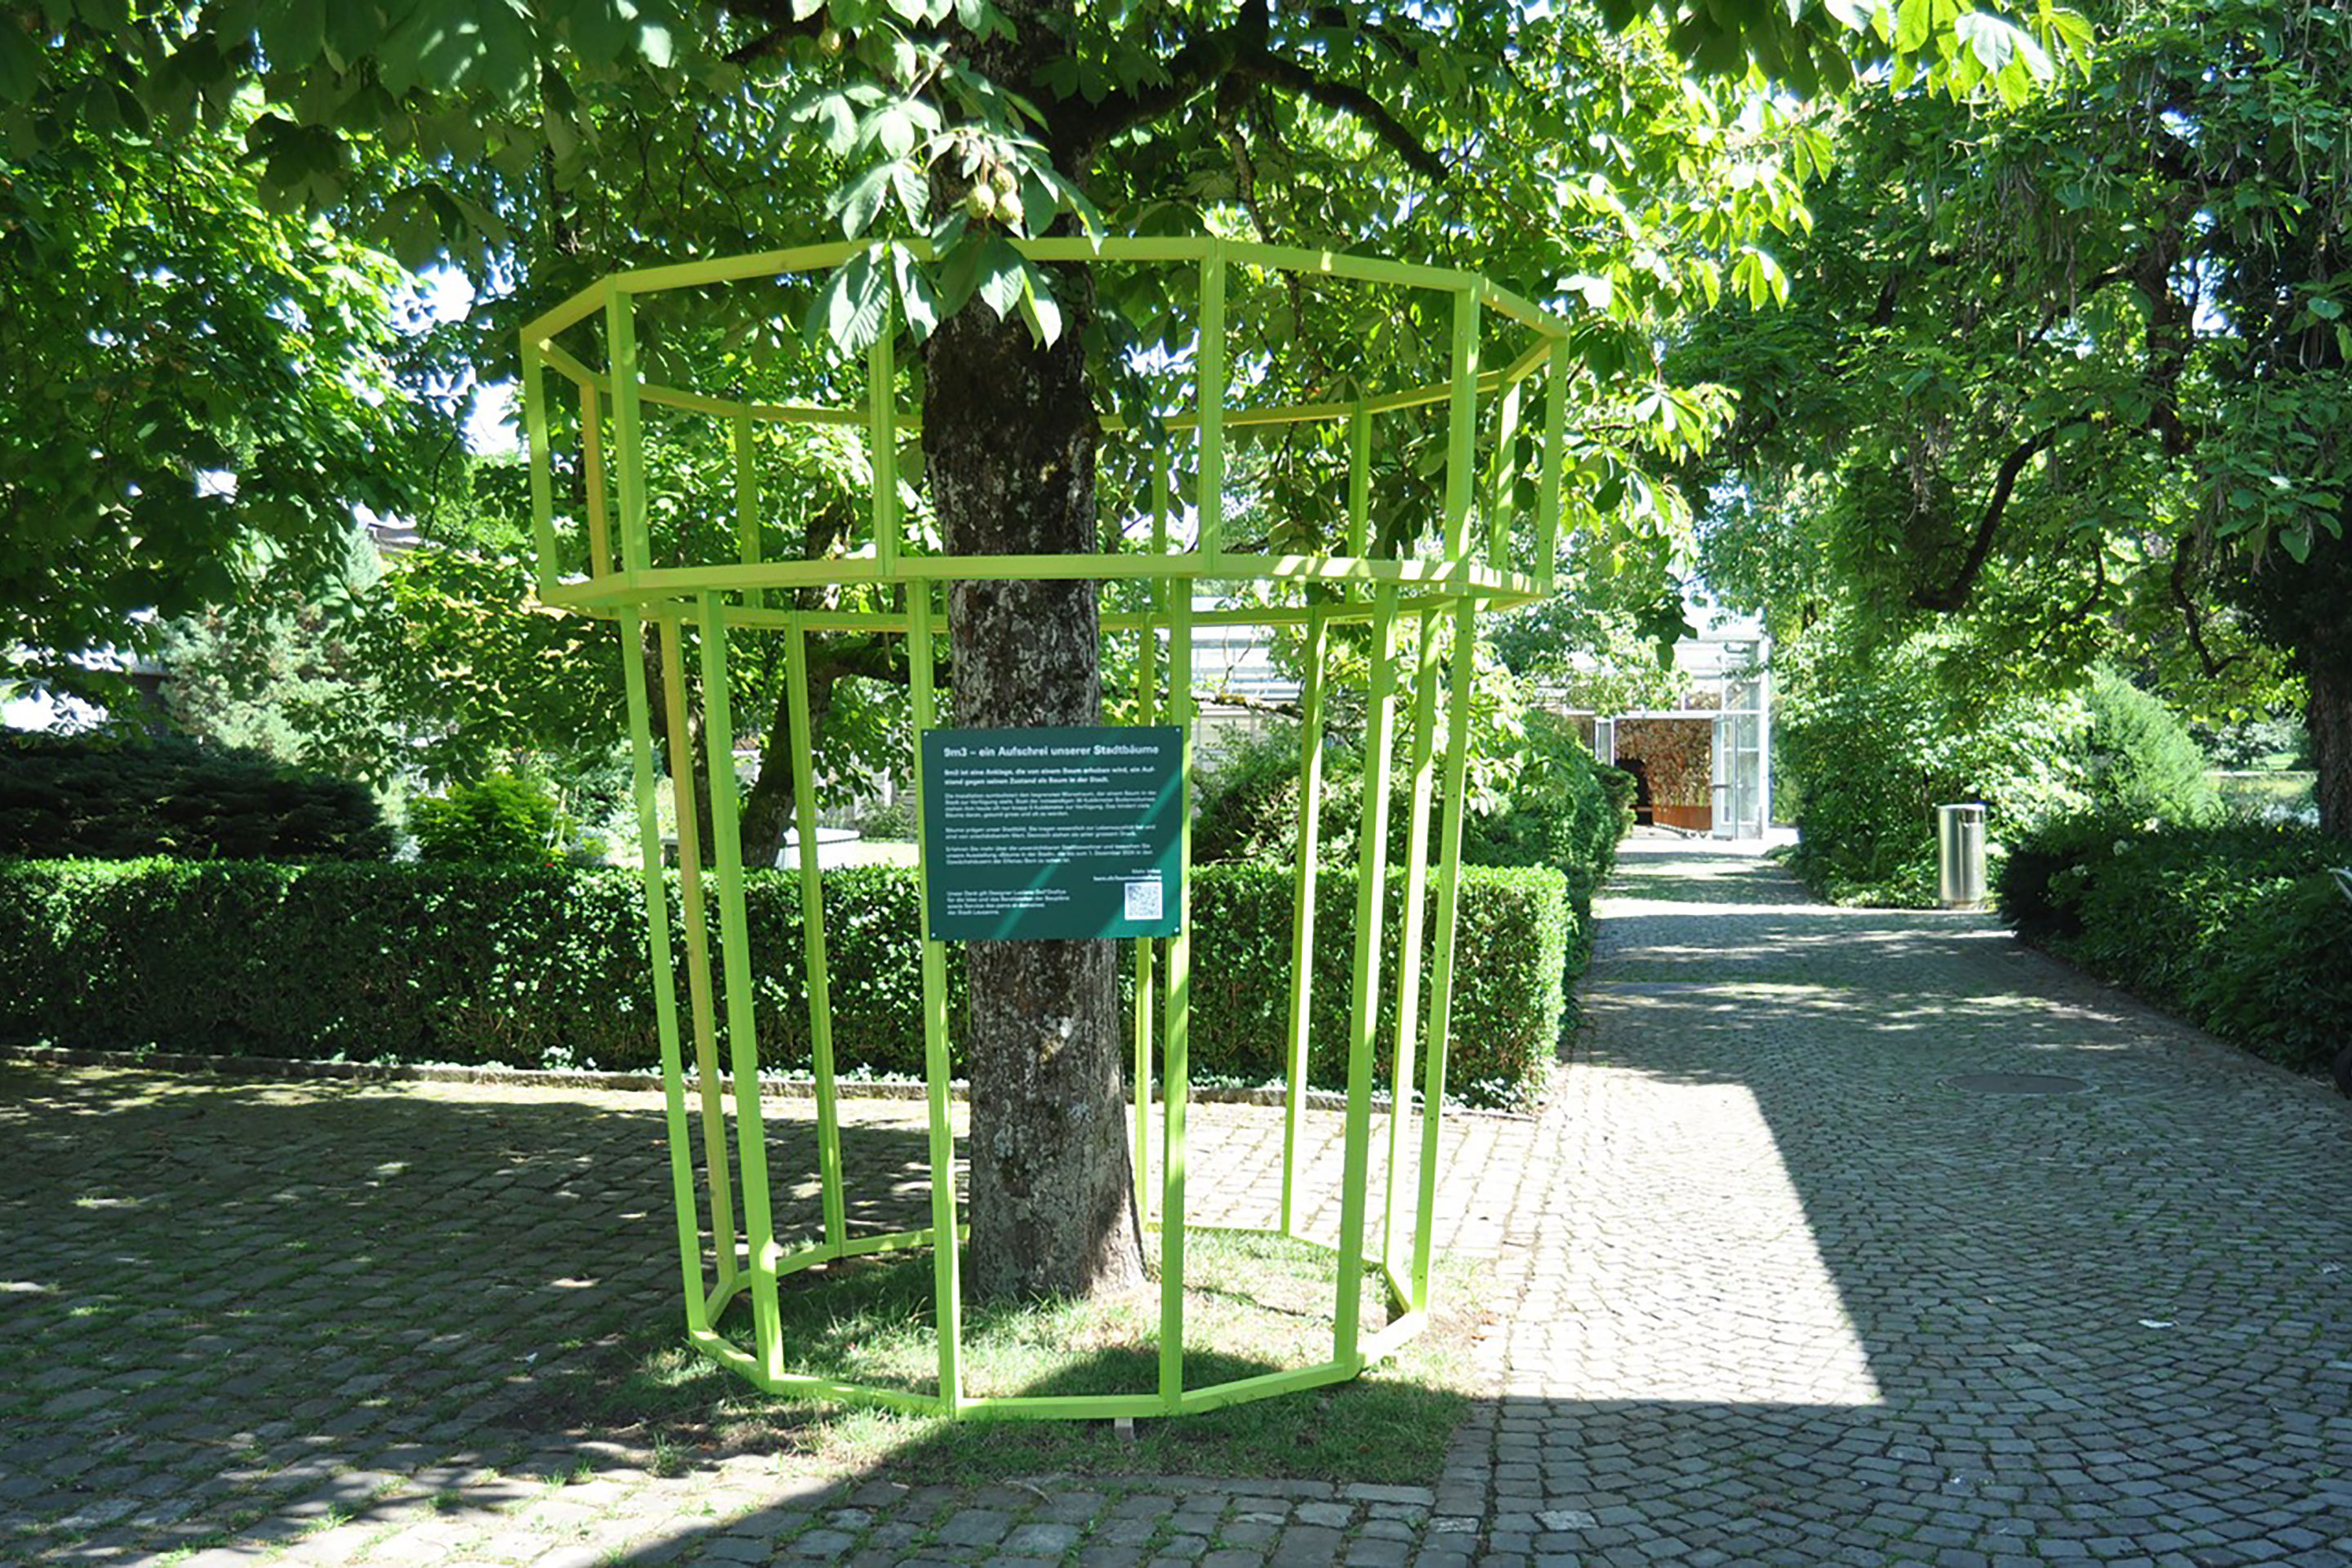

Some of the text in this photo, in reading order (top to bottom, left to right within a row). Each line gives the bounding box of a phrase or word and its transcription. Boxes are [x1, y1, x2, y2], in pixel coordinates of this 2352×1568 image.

[943, 746, 967, 758] 9m3
[979, 746, 996, 757] ein
[997, 745, 1049, 756] Aufschrei
[1050, 746, 1091, 755] unserer
[1093, 744, 1159, 755] Stadtbäume
